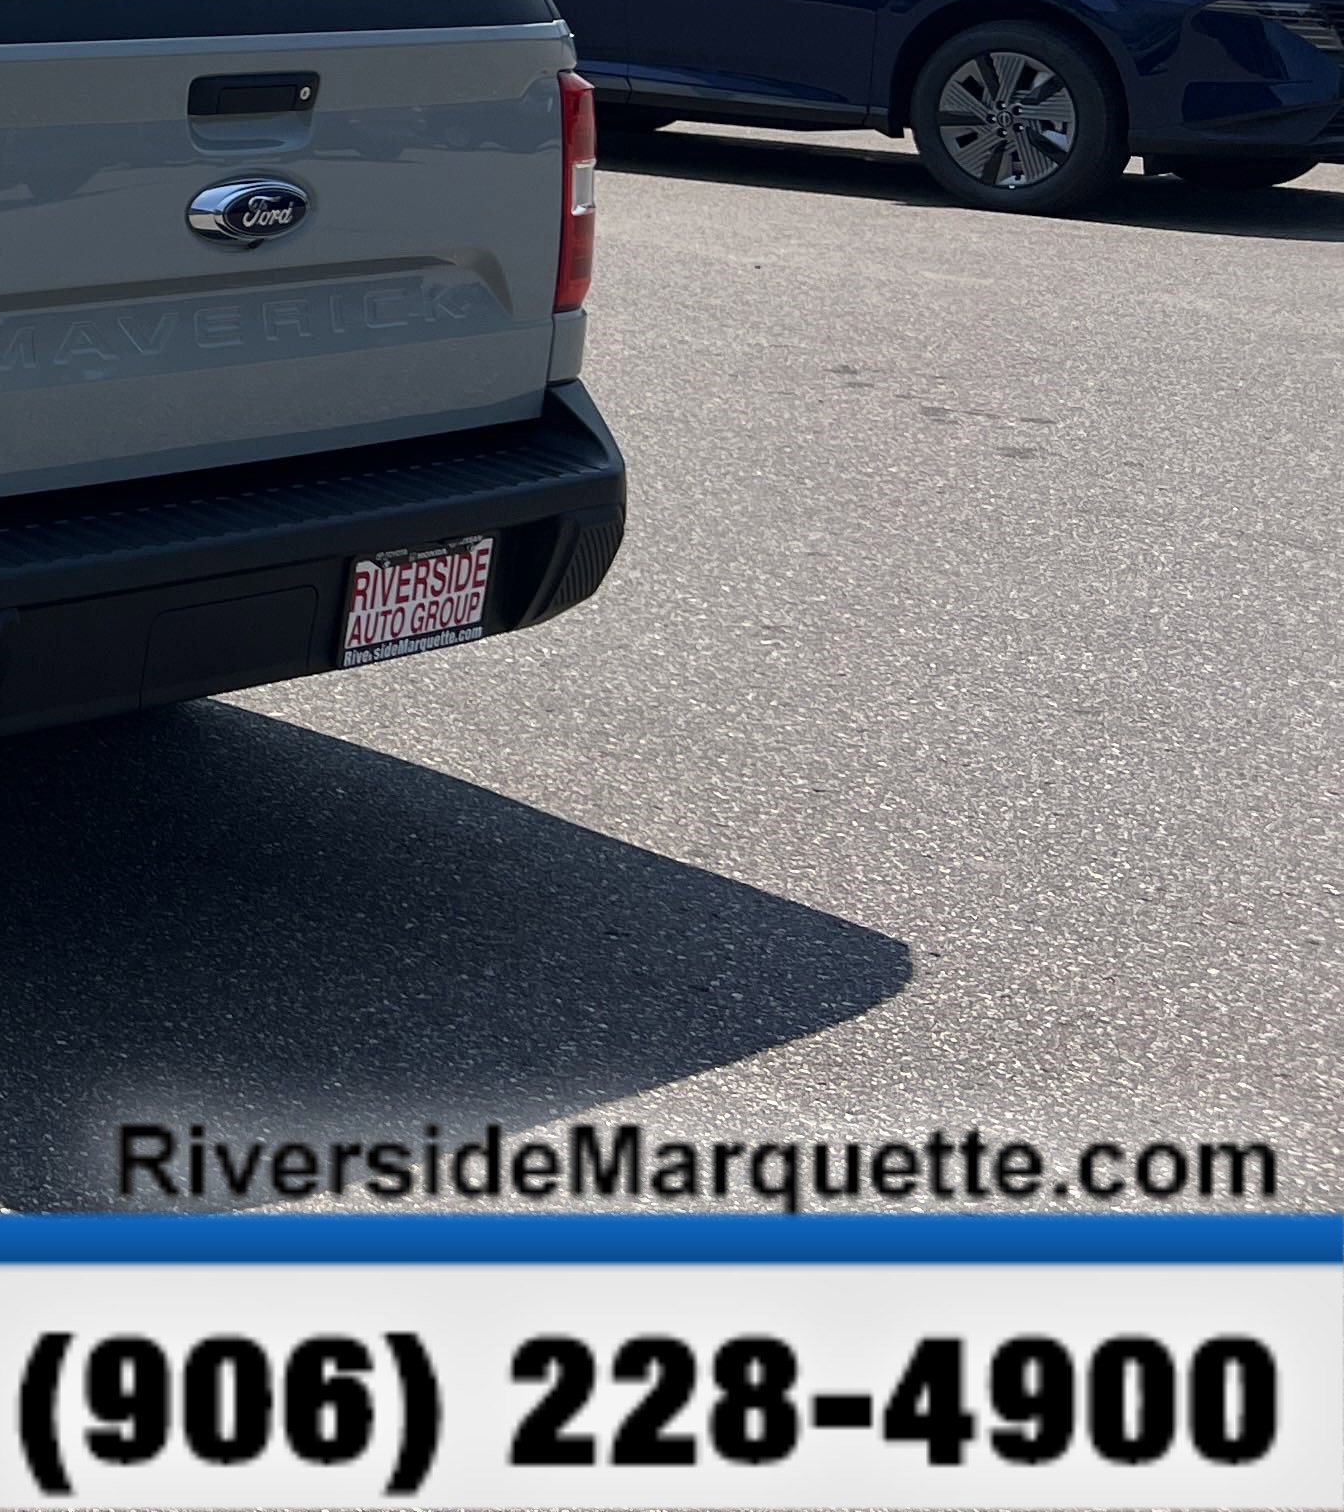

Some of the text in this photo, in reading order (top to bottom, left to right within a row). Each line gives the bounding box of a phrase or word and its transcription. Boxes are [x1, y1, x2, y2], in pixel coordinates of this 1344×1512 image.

[242, 195, 294, 228] Ford
[351, 548, 490, 612] RIVERSIDE
[347, 591, 481, 647] AUTO GROUP
